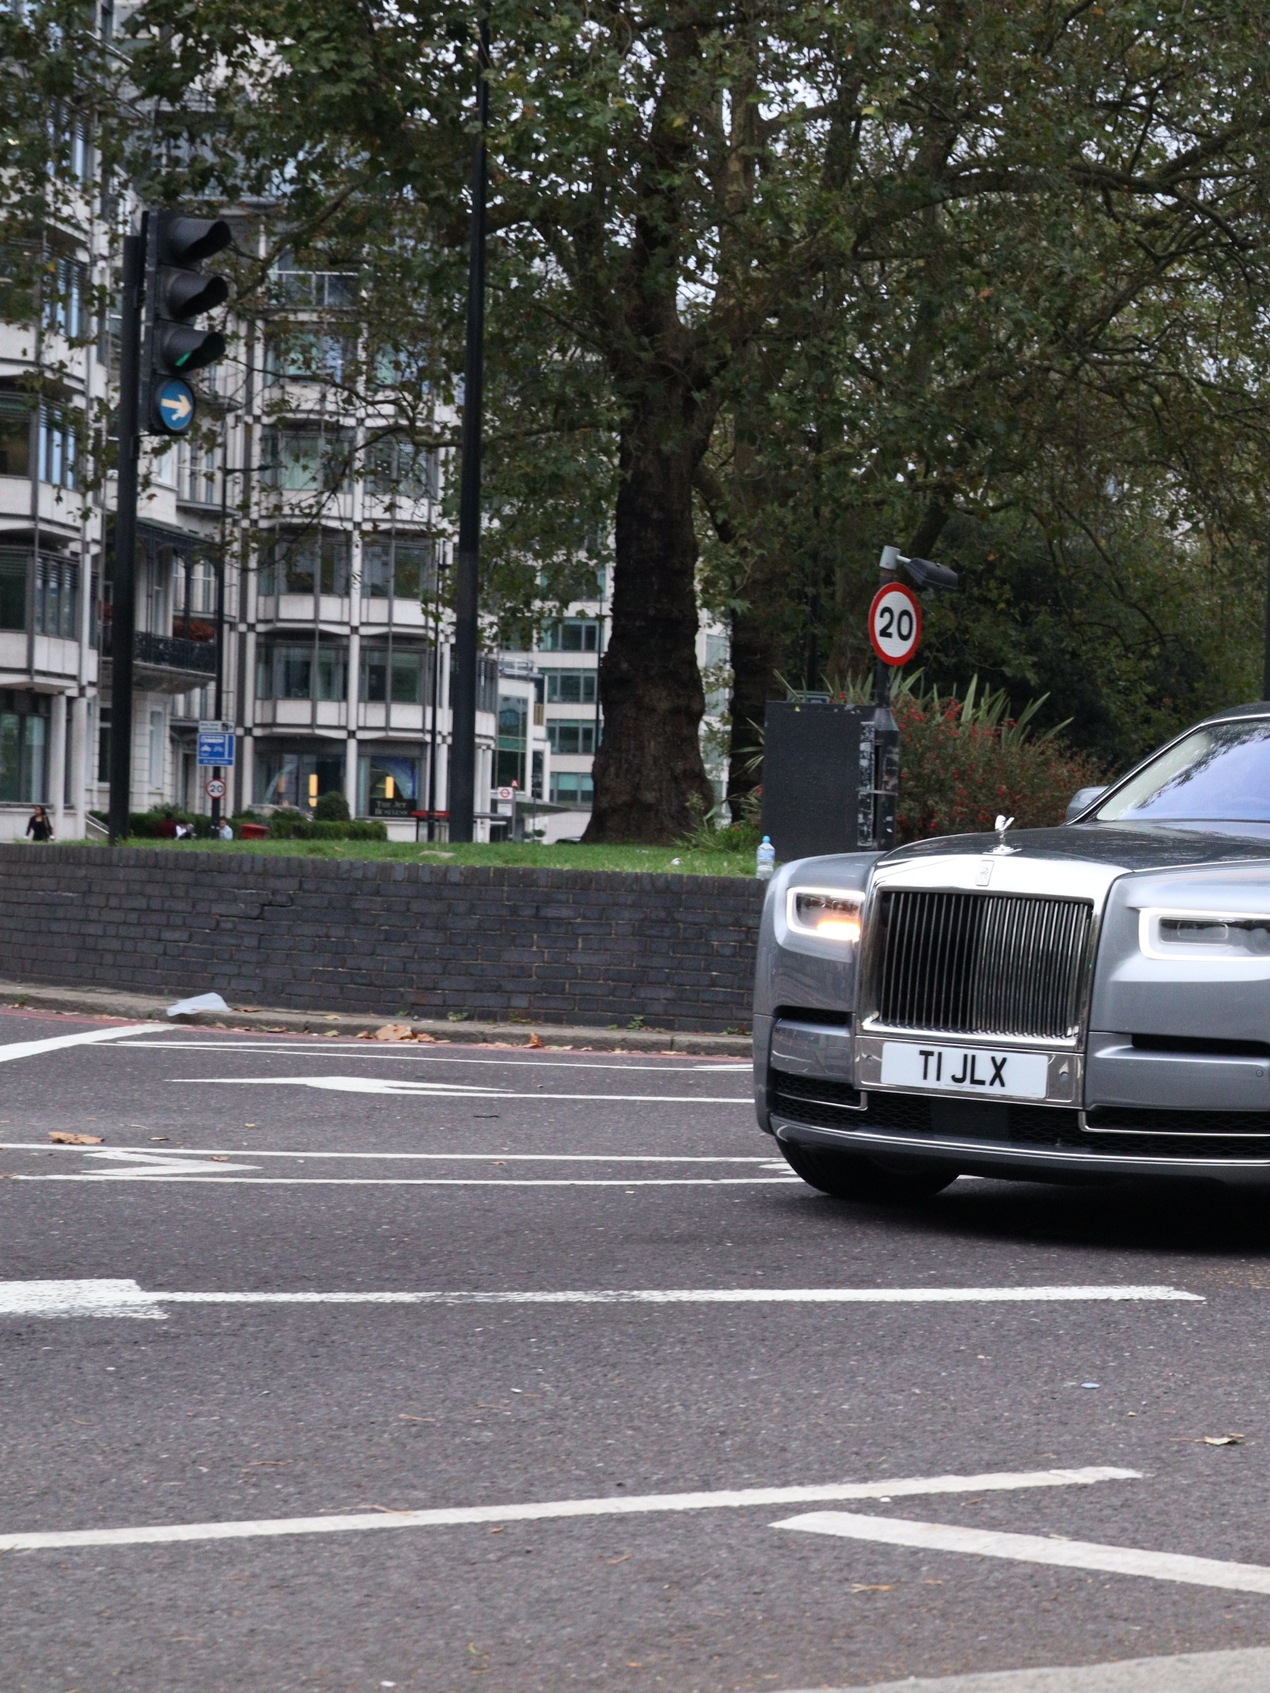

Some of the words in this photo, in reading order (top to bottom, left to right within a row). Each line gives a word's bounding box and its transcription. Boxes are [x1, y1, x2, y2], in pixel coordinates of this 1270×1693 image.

[879, 606, 914, 641] 20
[210, 784, 223, 793] 20
[951, 1054, 1007, 1087] JLX
